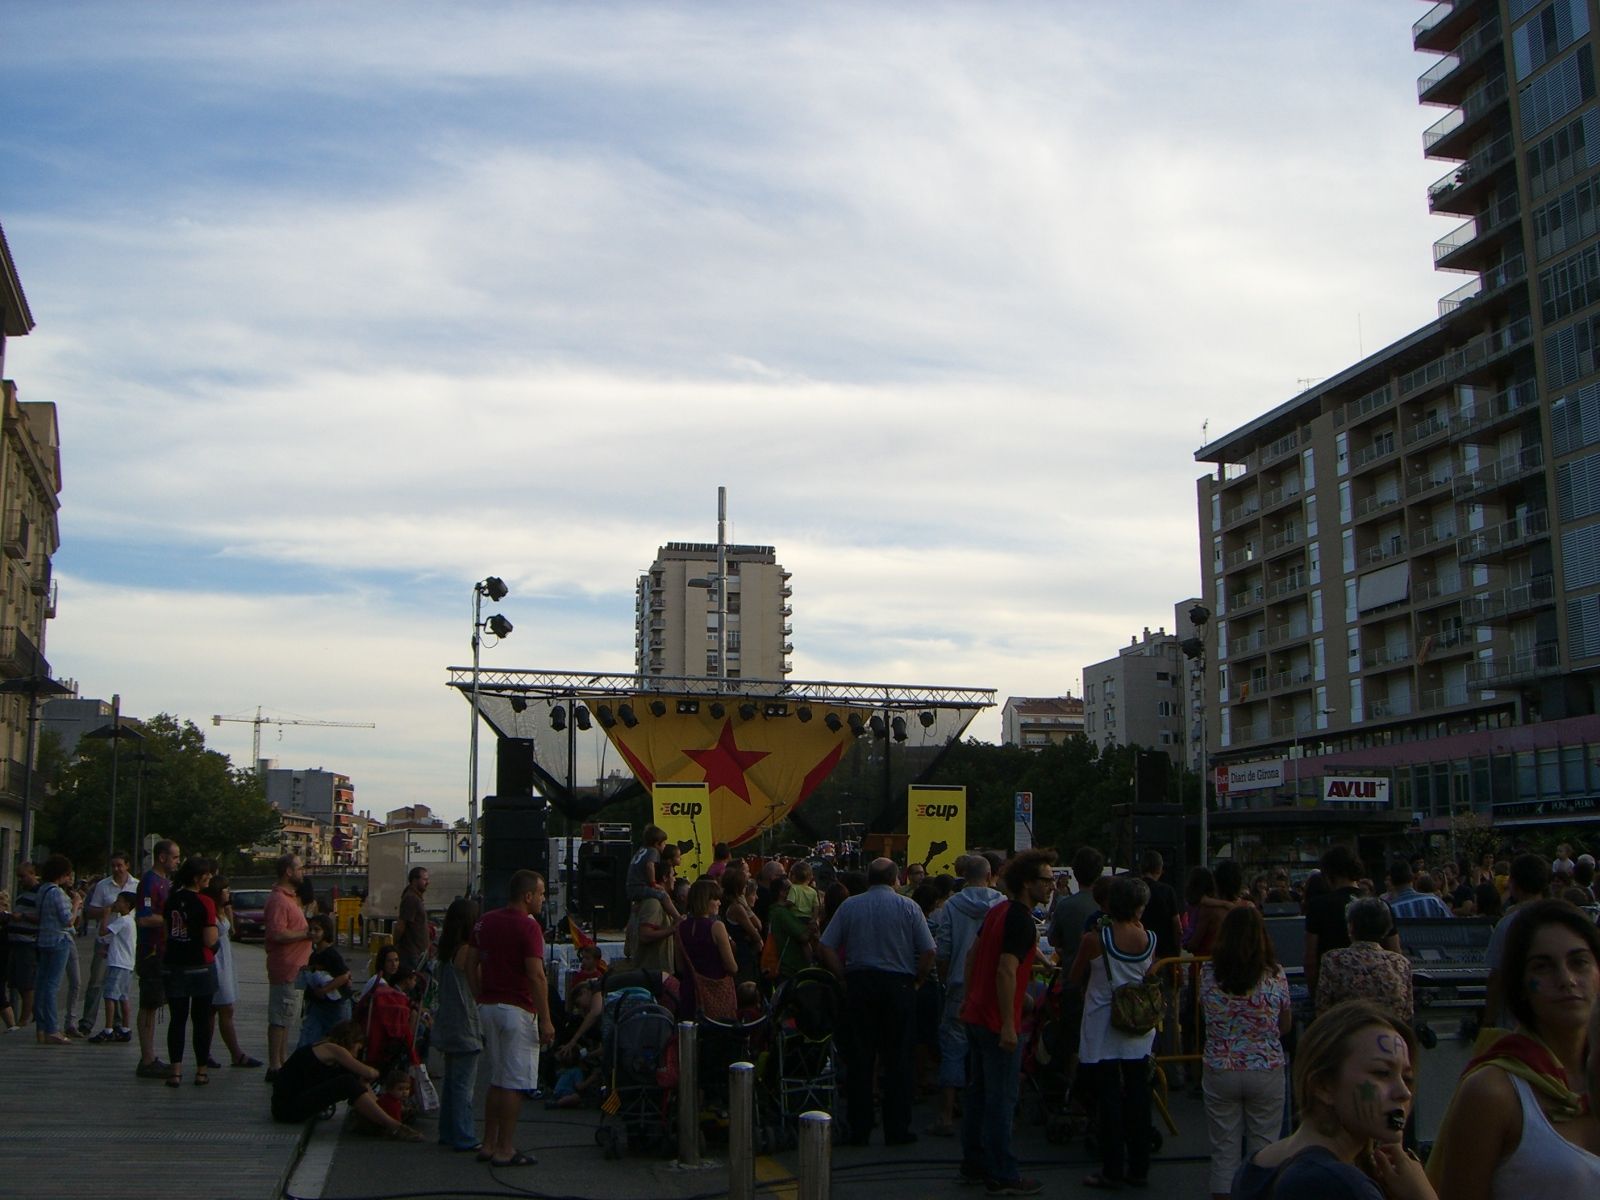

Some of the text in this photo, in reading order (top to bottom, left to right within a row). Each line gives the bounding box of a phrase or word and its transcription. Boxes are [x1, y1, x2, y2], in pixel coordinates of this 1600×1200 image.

[1231, 768, 1280, 784] Diari de Girona
[670, 802, 703, 819] cup
[925, 804, 959, 821] cup
